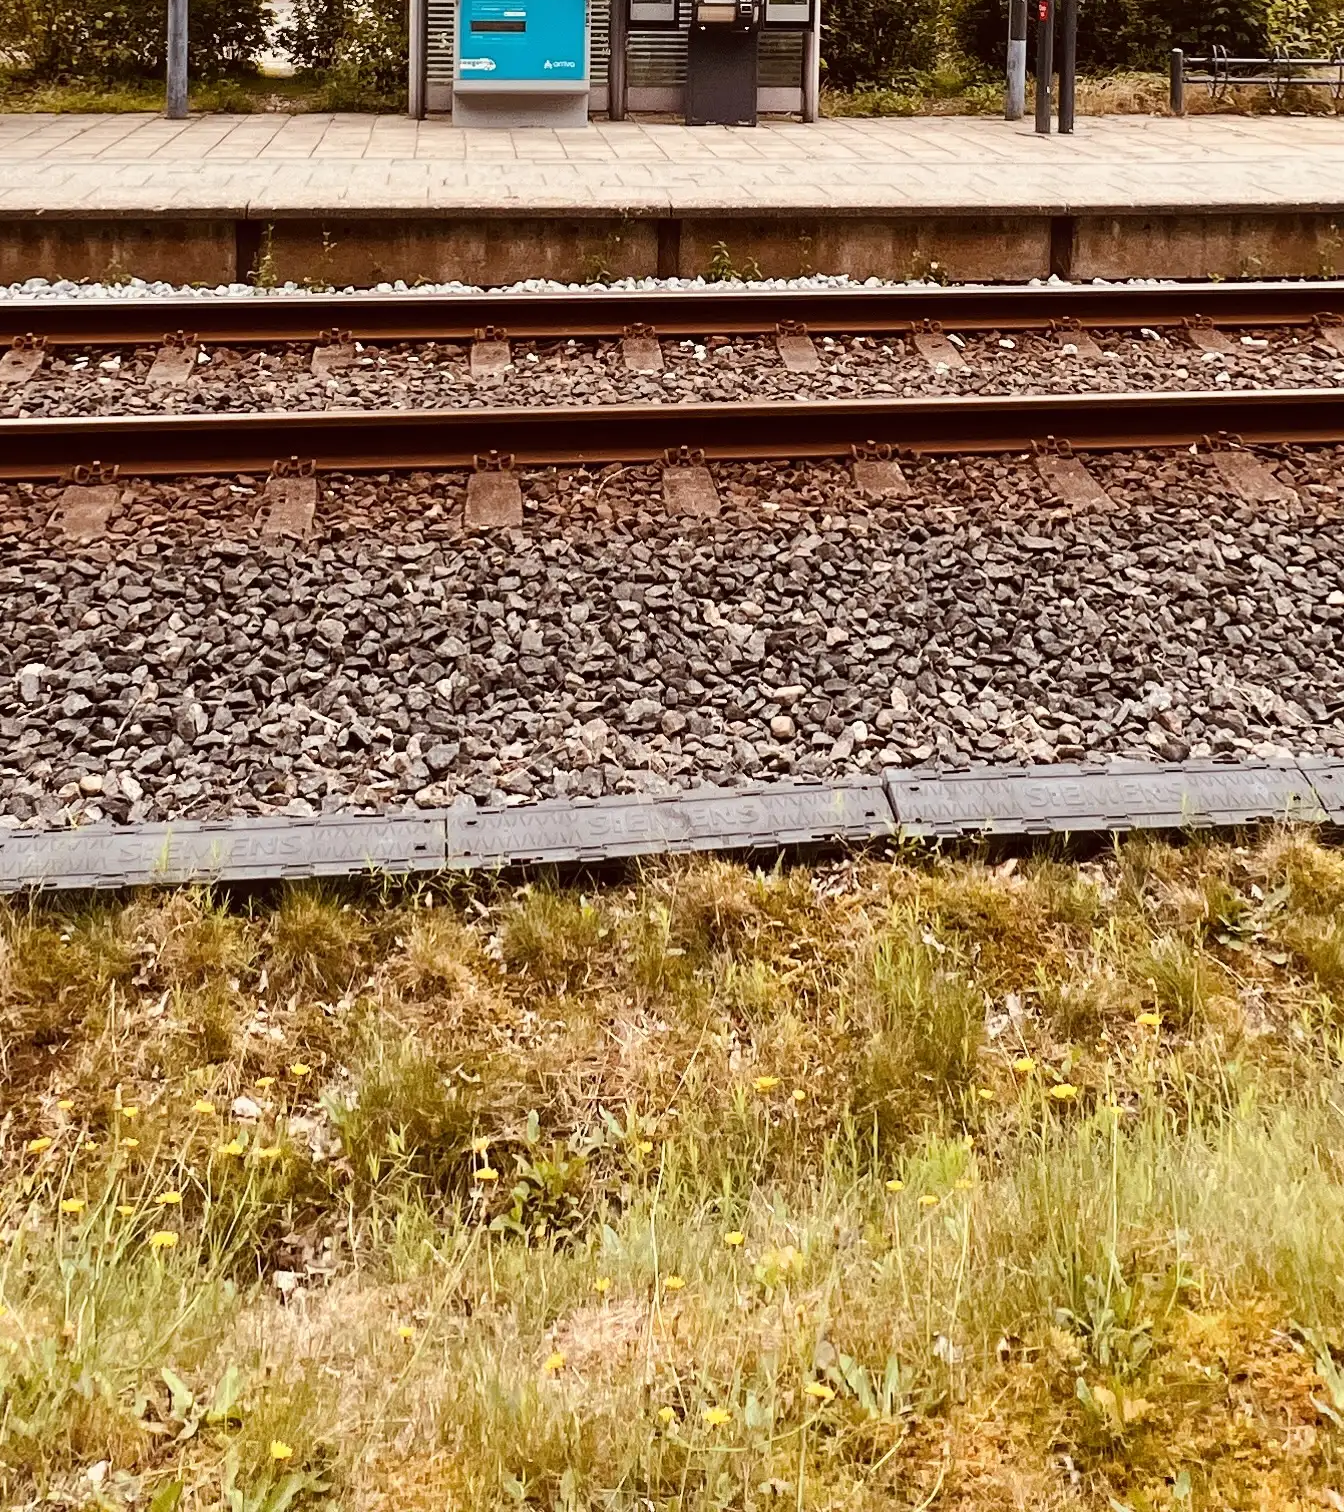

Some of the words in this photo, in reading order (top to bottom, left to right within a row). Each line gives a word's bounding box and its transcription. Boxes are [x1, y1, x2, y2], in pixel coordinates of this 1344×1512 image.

[552, 60, 576, 68] arriva
[1025, 781, 1184, 808] SIEMENS
[586, 803, 760, 836] SIEMENS
